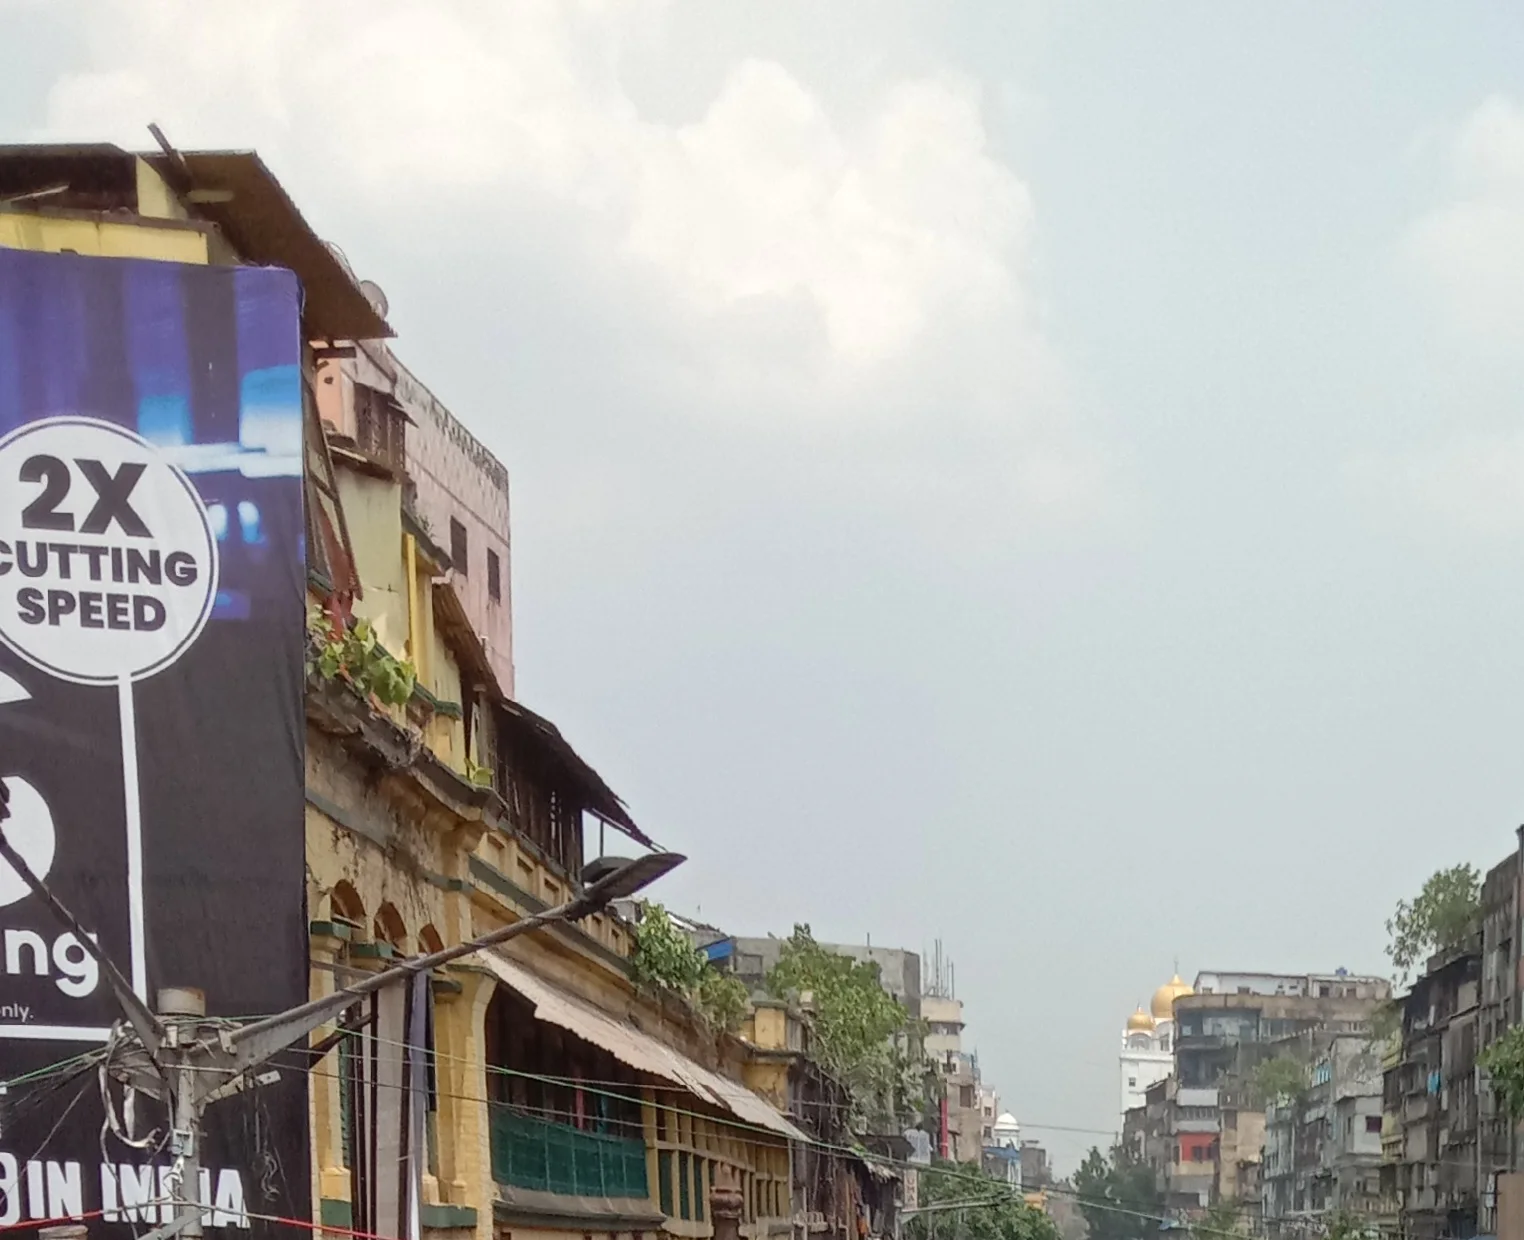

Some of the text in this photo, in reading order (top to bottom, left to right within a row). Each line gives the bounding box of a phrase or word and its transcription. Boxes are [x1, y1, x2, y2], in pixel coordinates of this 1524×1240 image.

[19, 454, 154, 539] 2X
[16, 588, 167, 632] SPEED
[0, 1003, 34, 1023] nly.
